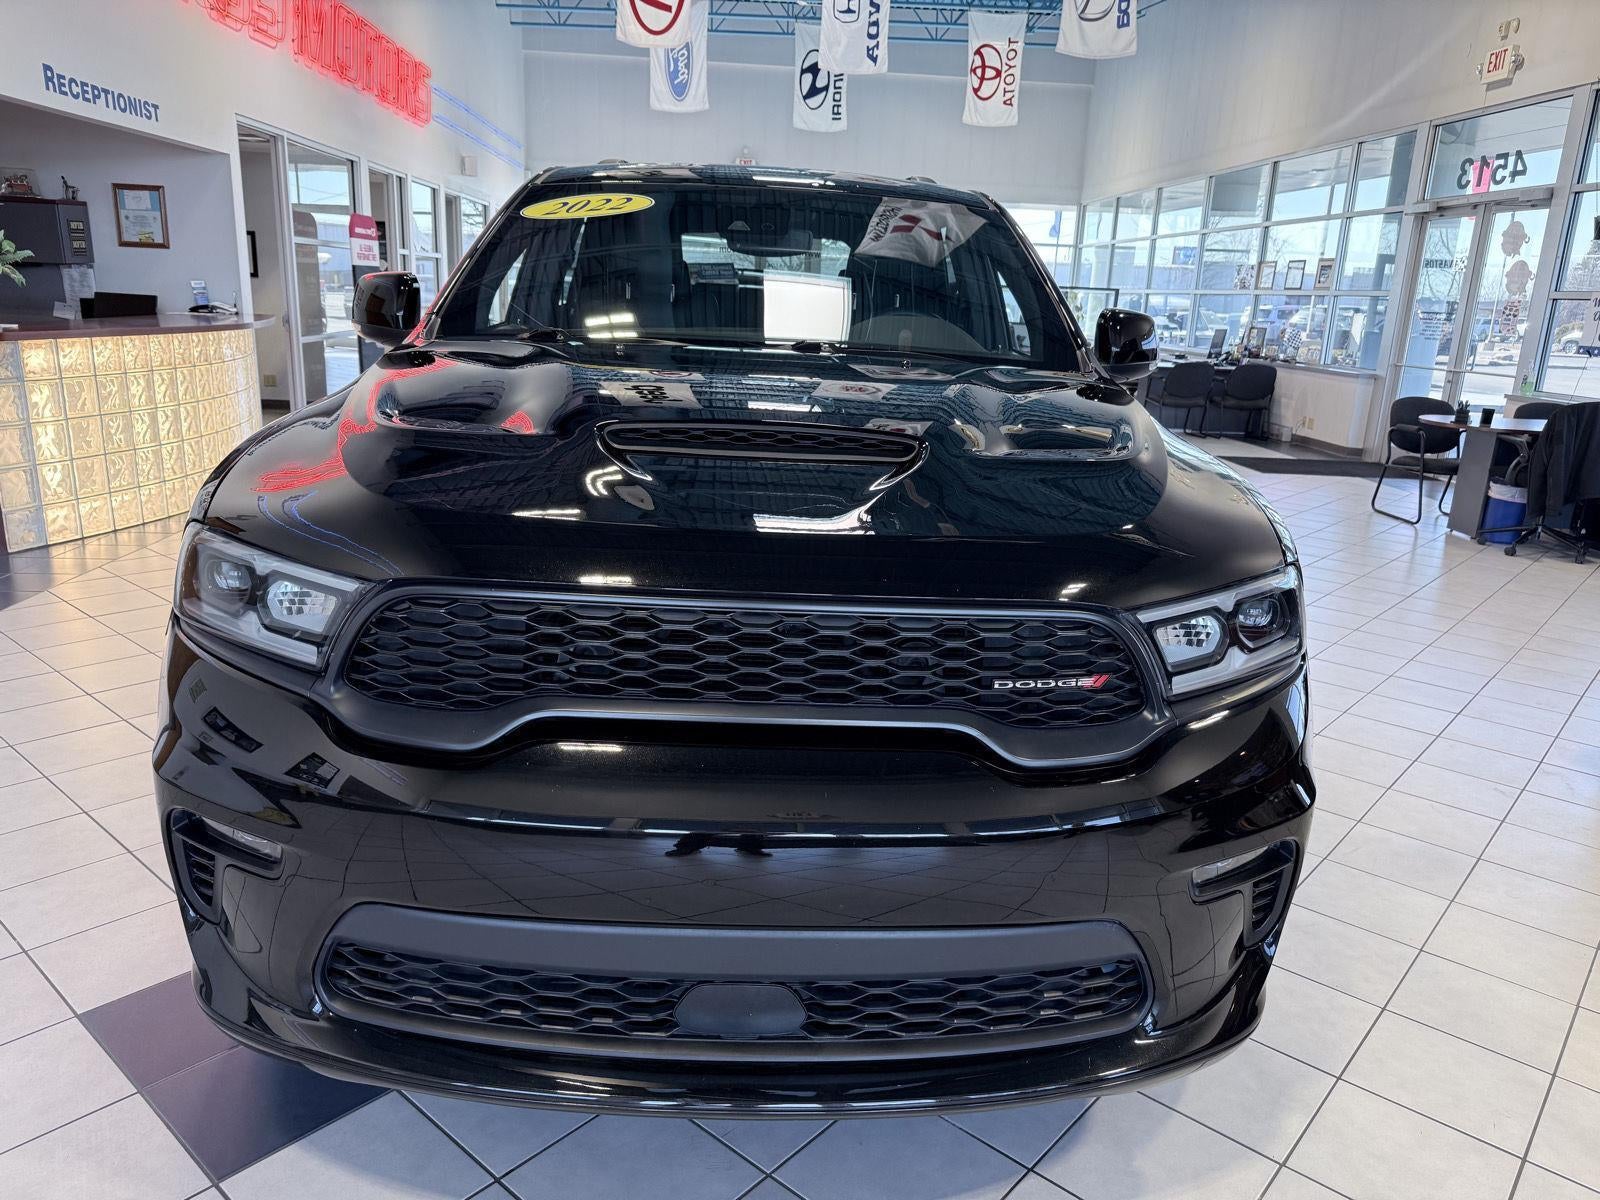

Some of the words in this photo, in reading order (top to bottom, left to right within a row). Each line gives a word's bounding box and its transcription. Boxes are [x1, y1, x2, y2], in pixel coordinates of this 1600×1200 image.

[1486, 48, 1509, 74] EXIT
[42, 62, 160, 122] RECEPTIONIST
[545, 197, 633, 216] 2022
[993, 678, 1096, 689] DODGE
